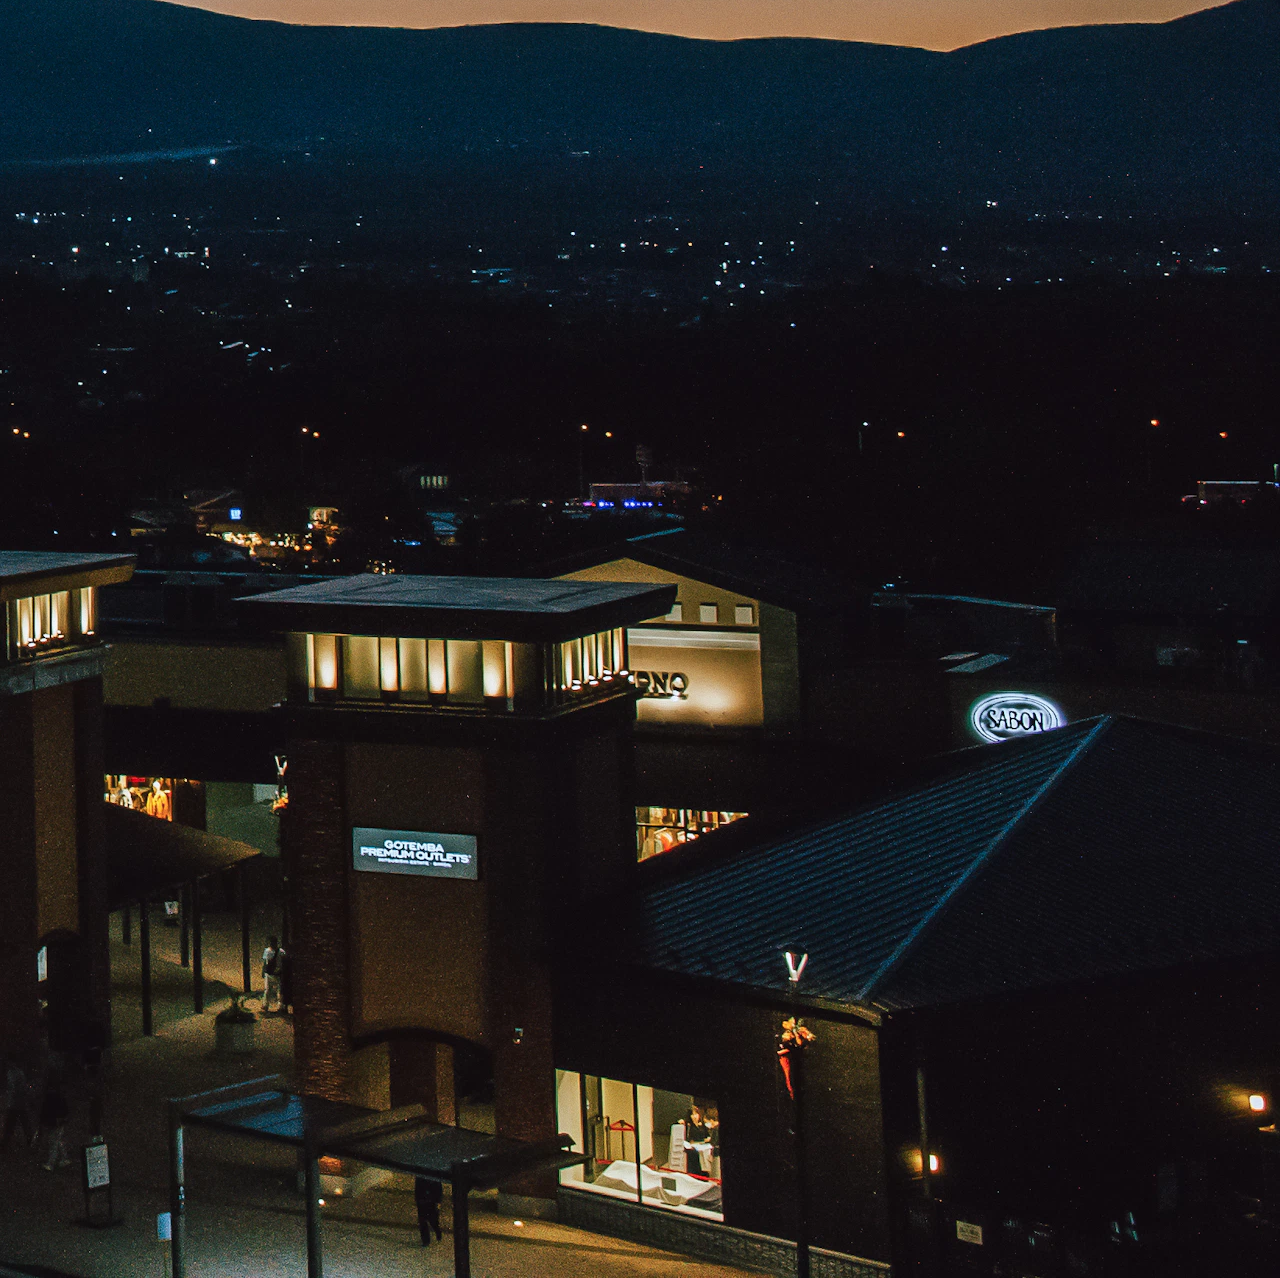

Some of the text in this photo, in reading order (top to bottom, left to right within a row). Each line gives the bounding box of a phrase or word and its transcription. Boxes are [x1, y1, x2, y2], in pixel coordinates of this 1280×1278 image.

[986, 709, 1045, 731] SABON
[383, 839, 445, 852] GOTEMBA
[360, 846, 415, 860] PREMIUM
